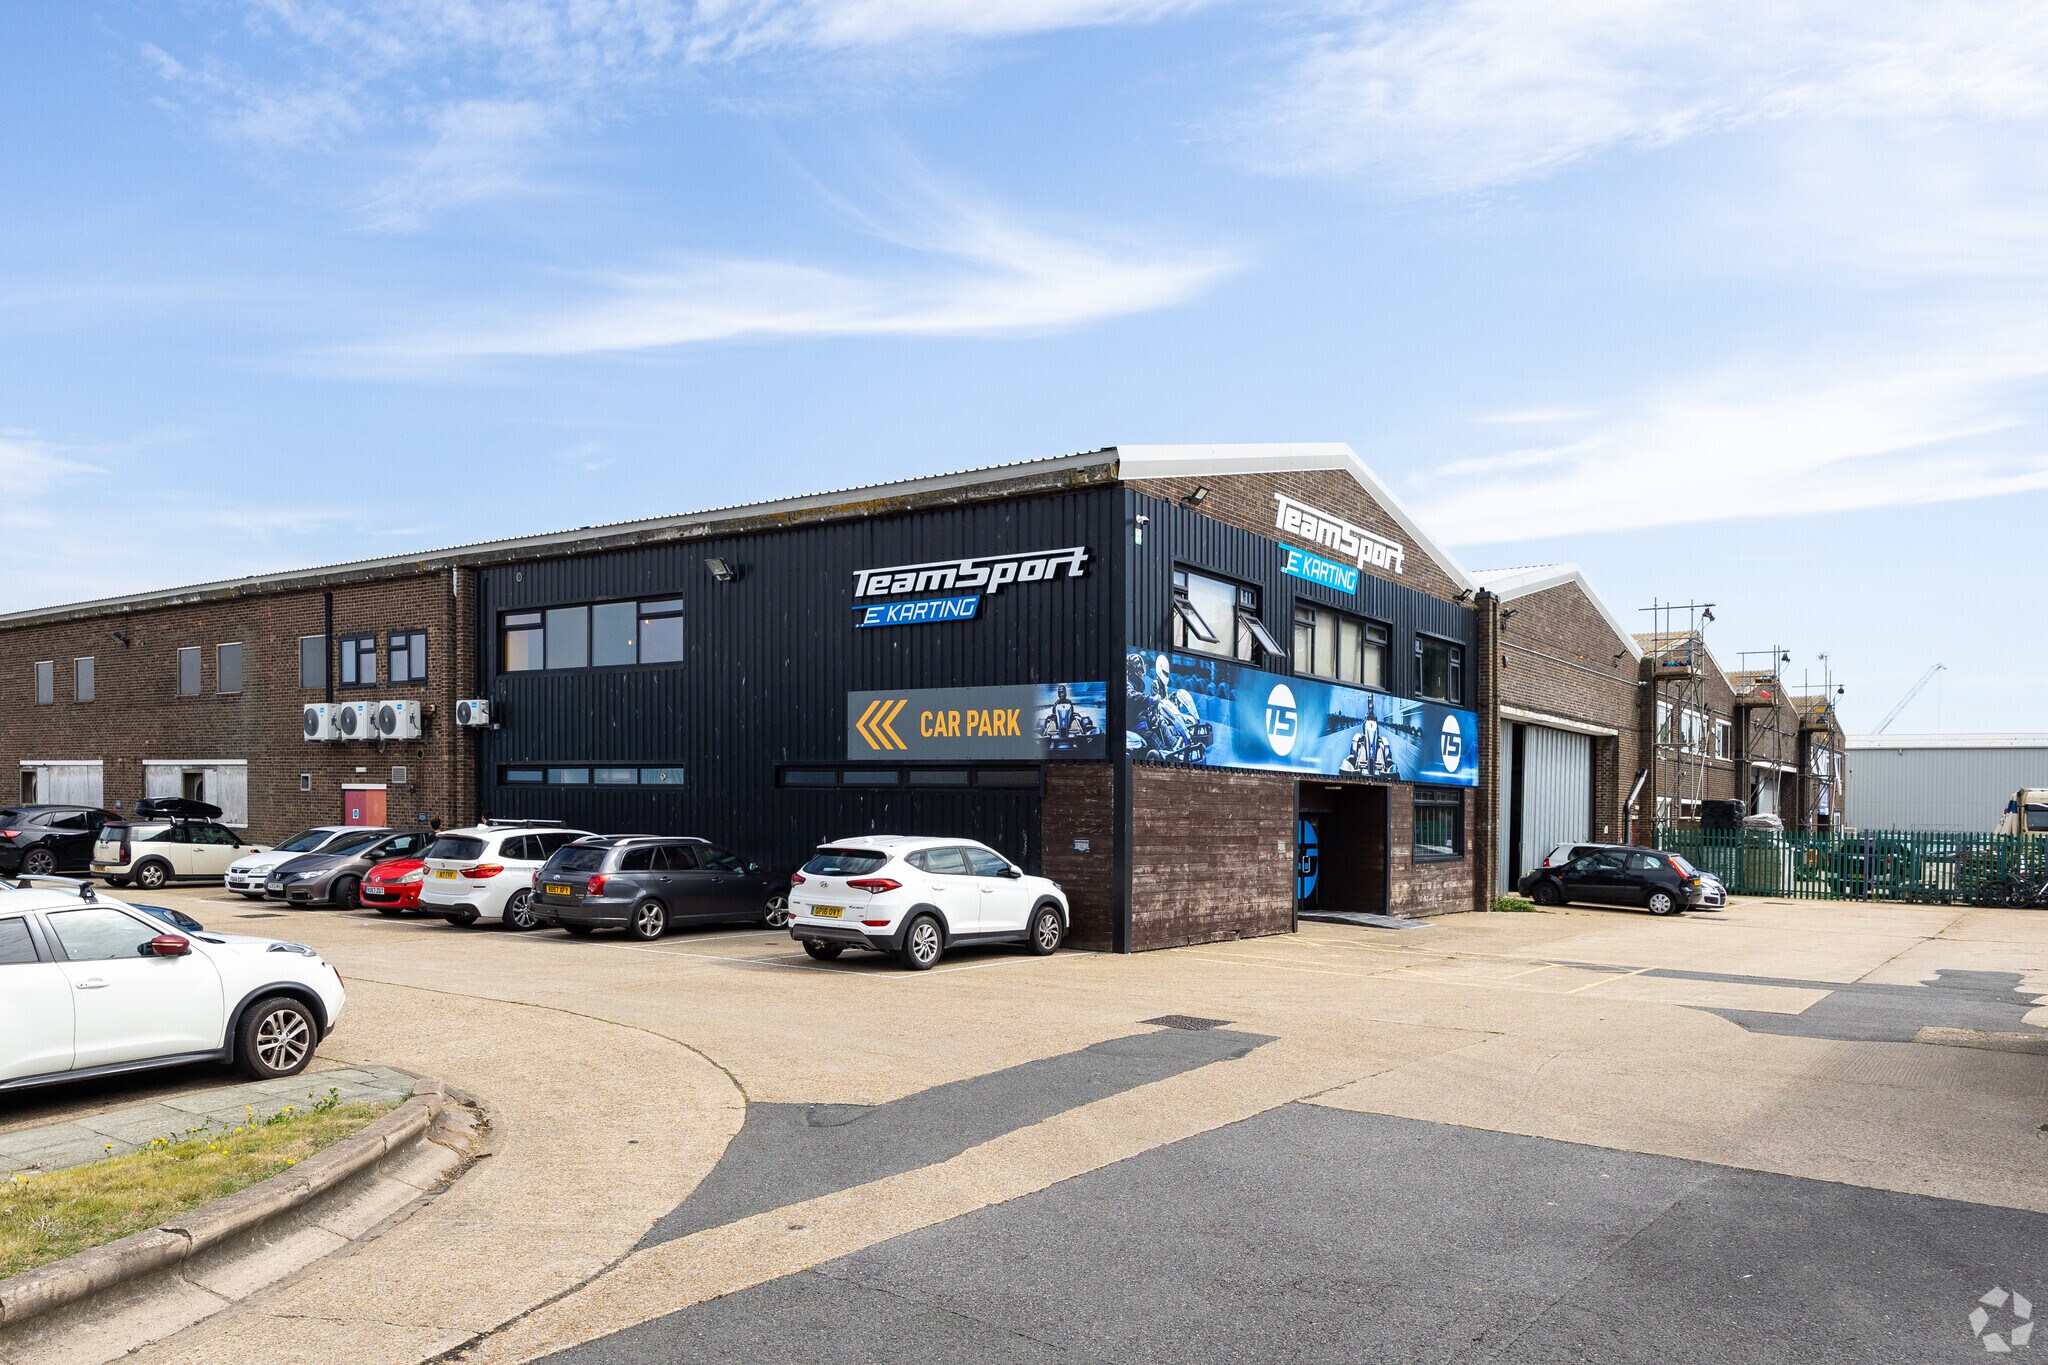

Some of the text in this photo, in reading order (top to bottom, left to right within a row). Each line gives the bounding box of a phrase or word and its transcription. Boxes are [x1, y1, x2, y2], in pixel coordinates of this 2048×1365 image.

[1274, 492, 1405, 575] TeamSport
[852, 546, 1089, 598] TeamSport
[1286, 550, 1357, 591] E KARTING
[863, 598, 977, 624] E KARTING
[920, 708, 1021, 738] CAR PARK
[815, 907, 828, 916] GP16
